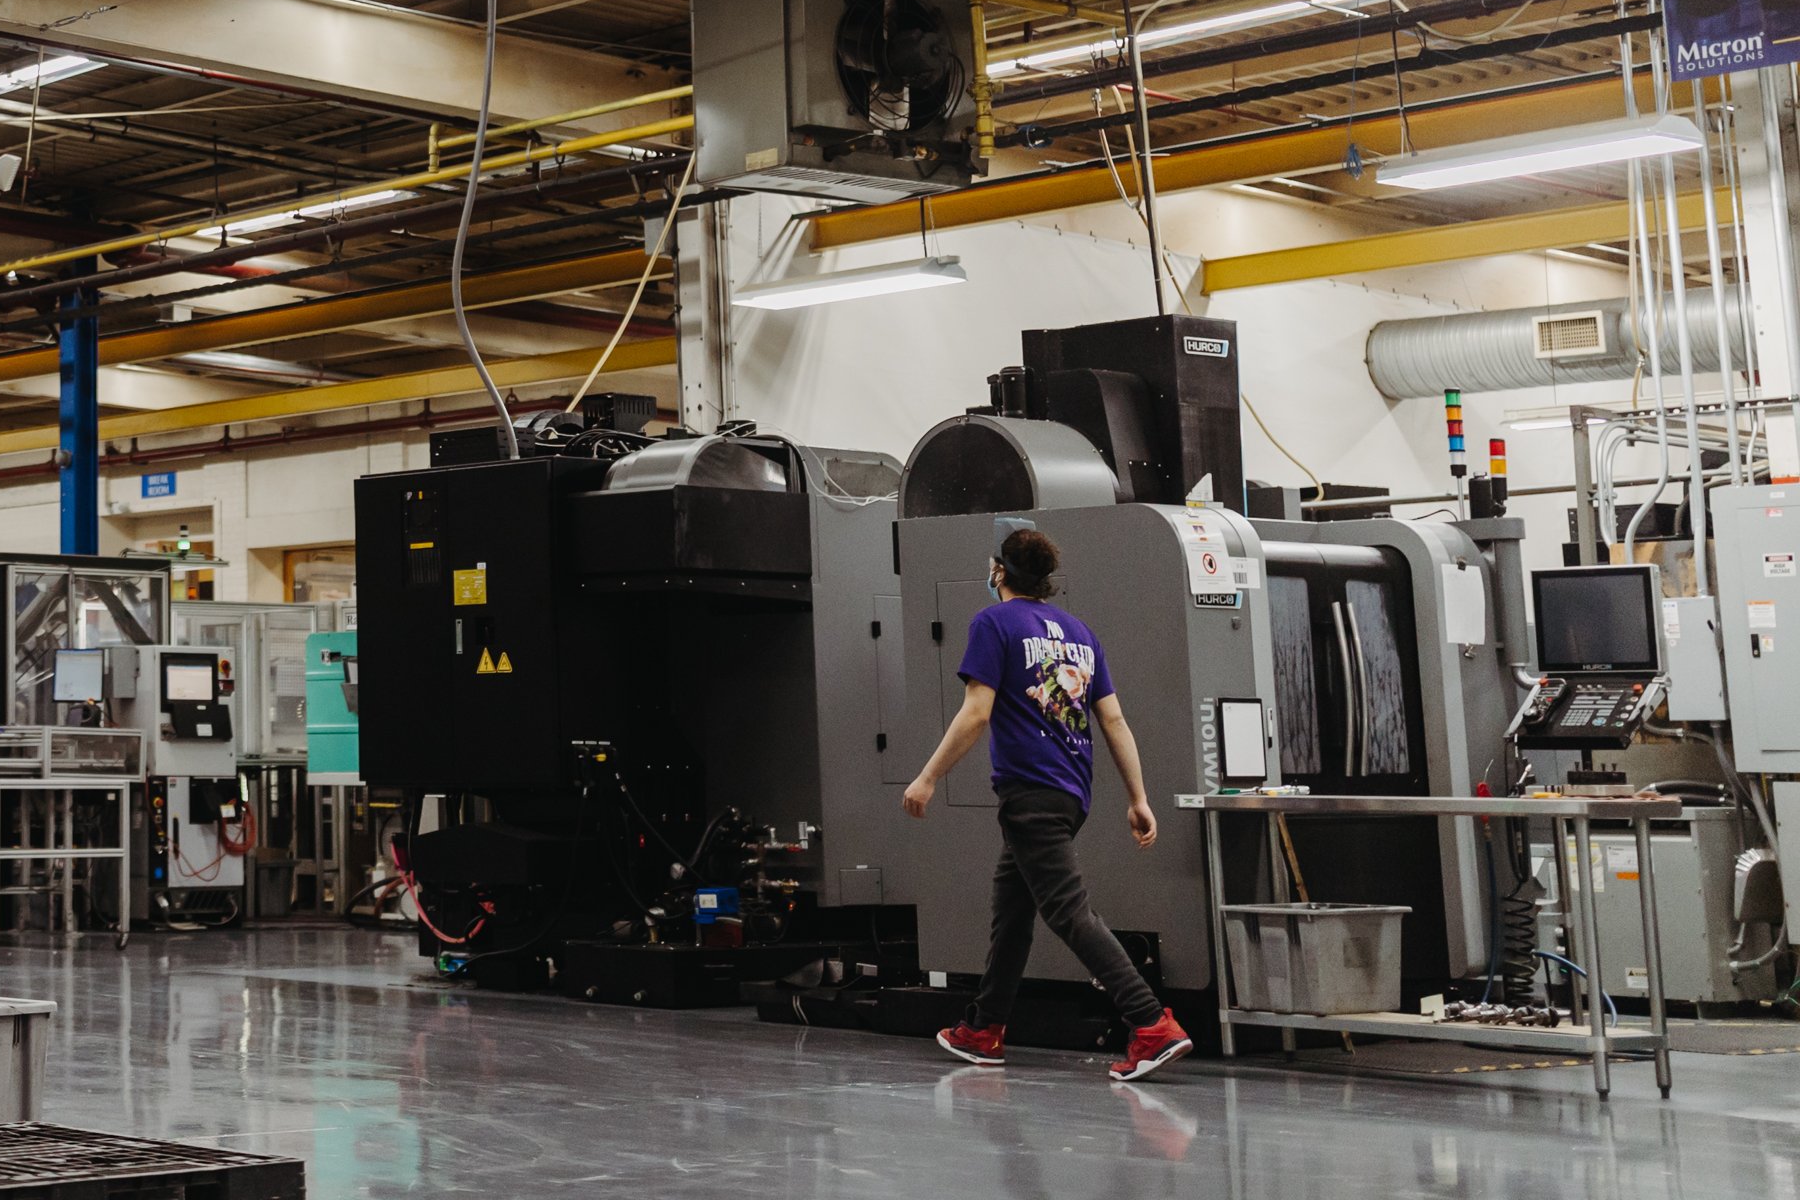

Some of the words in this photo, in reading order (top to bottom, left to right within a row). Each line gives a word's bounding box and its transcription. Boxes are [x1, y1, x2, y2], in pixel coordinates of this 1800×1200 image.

[1677, 33, 1763, 63] Micron
[1678, 50, 1764, 73] SOLUTIONS
[1187, 341, 1221, 352] HURCO
[1198, 593, 1234, 604] HURCO
[1044, 619, 1065, 640] NO
[1022, 637, 1065, 669] DRAMA
[1065, 642, 1095, 676] CLUB
